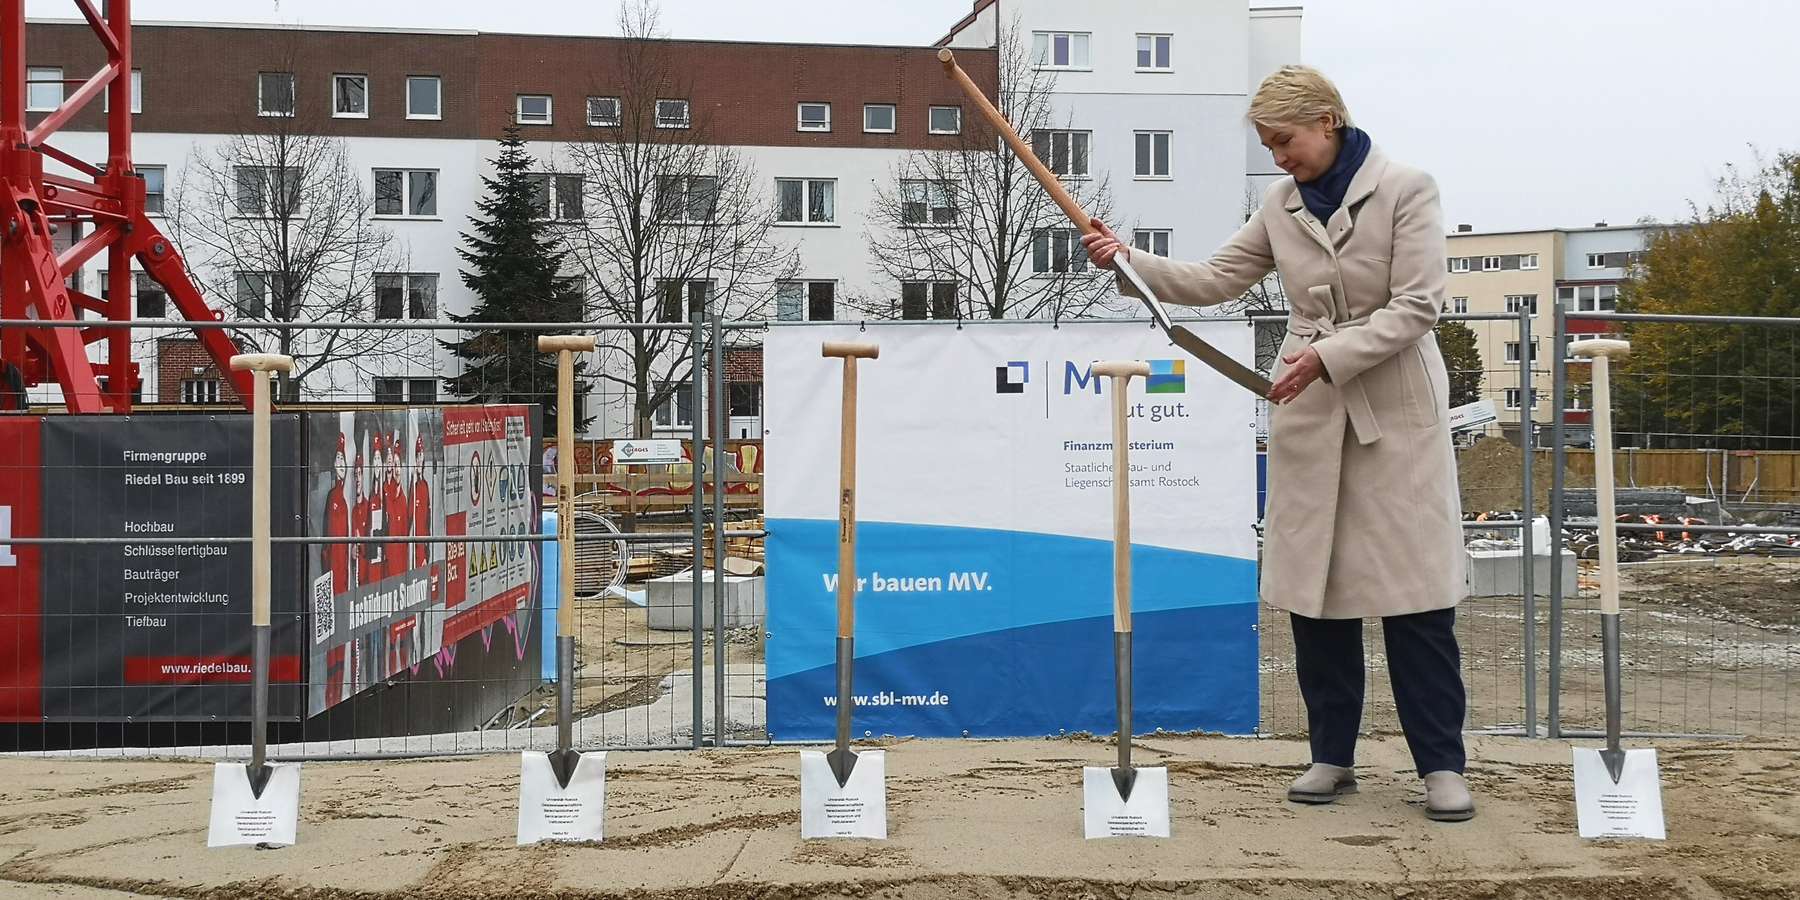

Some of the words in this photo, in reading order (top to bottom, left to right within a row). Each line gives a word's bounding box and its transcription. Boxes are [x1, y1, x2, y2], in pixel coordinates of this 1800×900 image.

[1126, 402, 1144, 418] ut
[1151, 402, 1189, 422] gut.
[1063, 440, 1174, 451] Finanzmsterium
[123, 450, 207, 464] Firmengruppe
[1065, 462, 1113, 473] Staatliche
[1151, 461, 1171, 472] und
[124, 473, 161, 485] Riedel
[165, 473, 189, 485] Bau
[192, 473, 214, 485] seit
[217, 473, 246, 484] 1899
[1065, 478, 1155, 489] Liegenschsamt
[1159, 476, 1199, 487] Rostock
[124, 521, 174, 533] Hochbau
[124, 544, 228, 559] Schlüsselfertigbau
[124, 568, 180, 582] Bauträger
[823, 573, 866, 592] Wr
[872, 572, 942, 592] bauen
[948, 572, 992, 591] MV.
[124, 592, 230, 605] Projektentwicklung
[126, 615, 167, 627] Tiefbau
[824, 691, 949, 706] ww.sbl-mv.de
